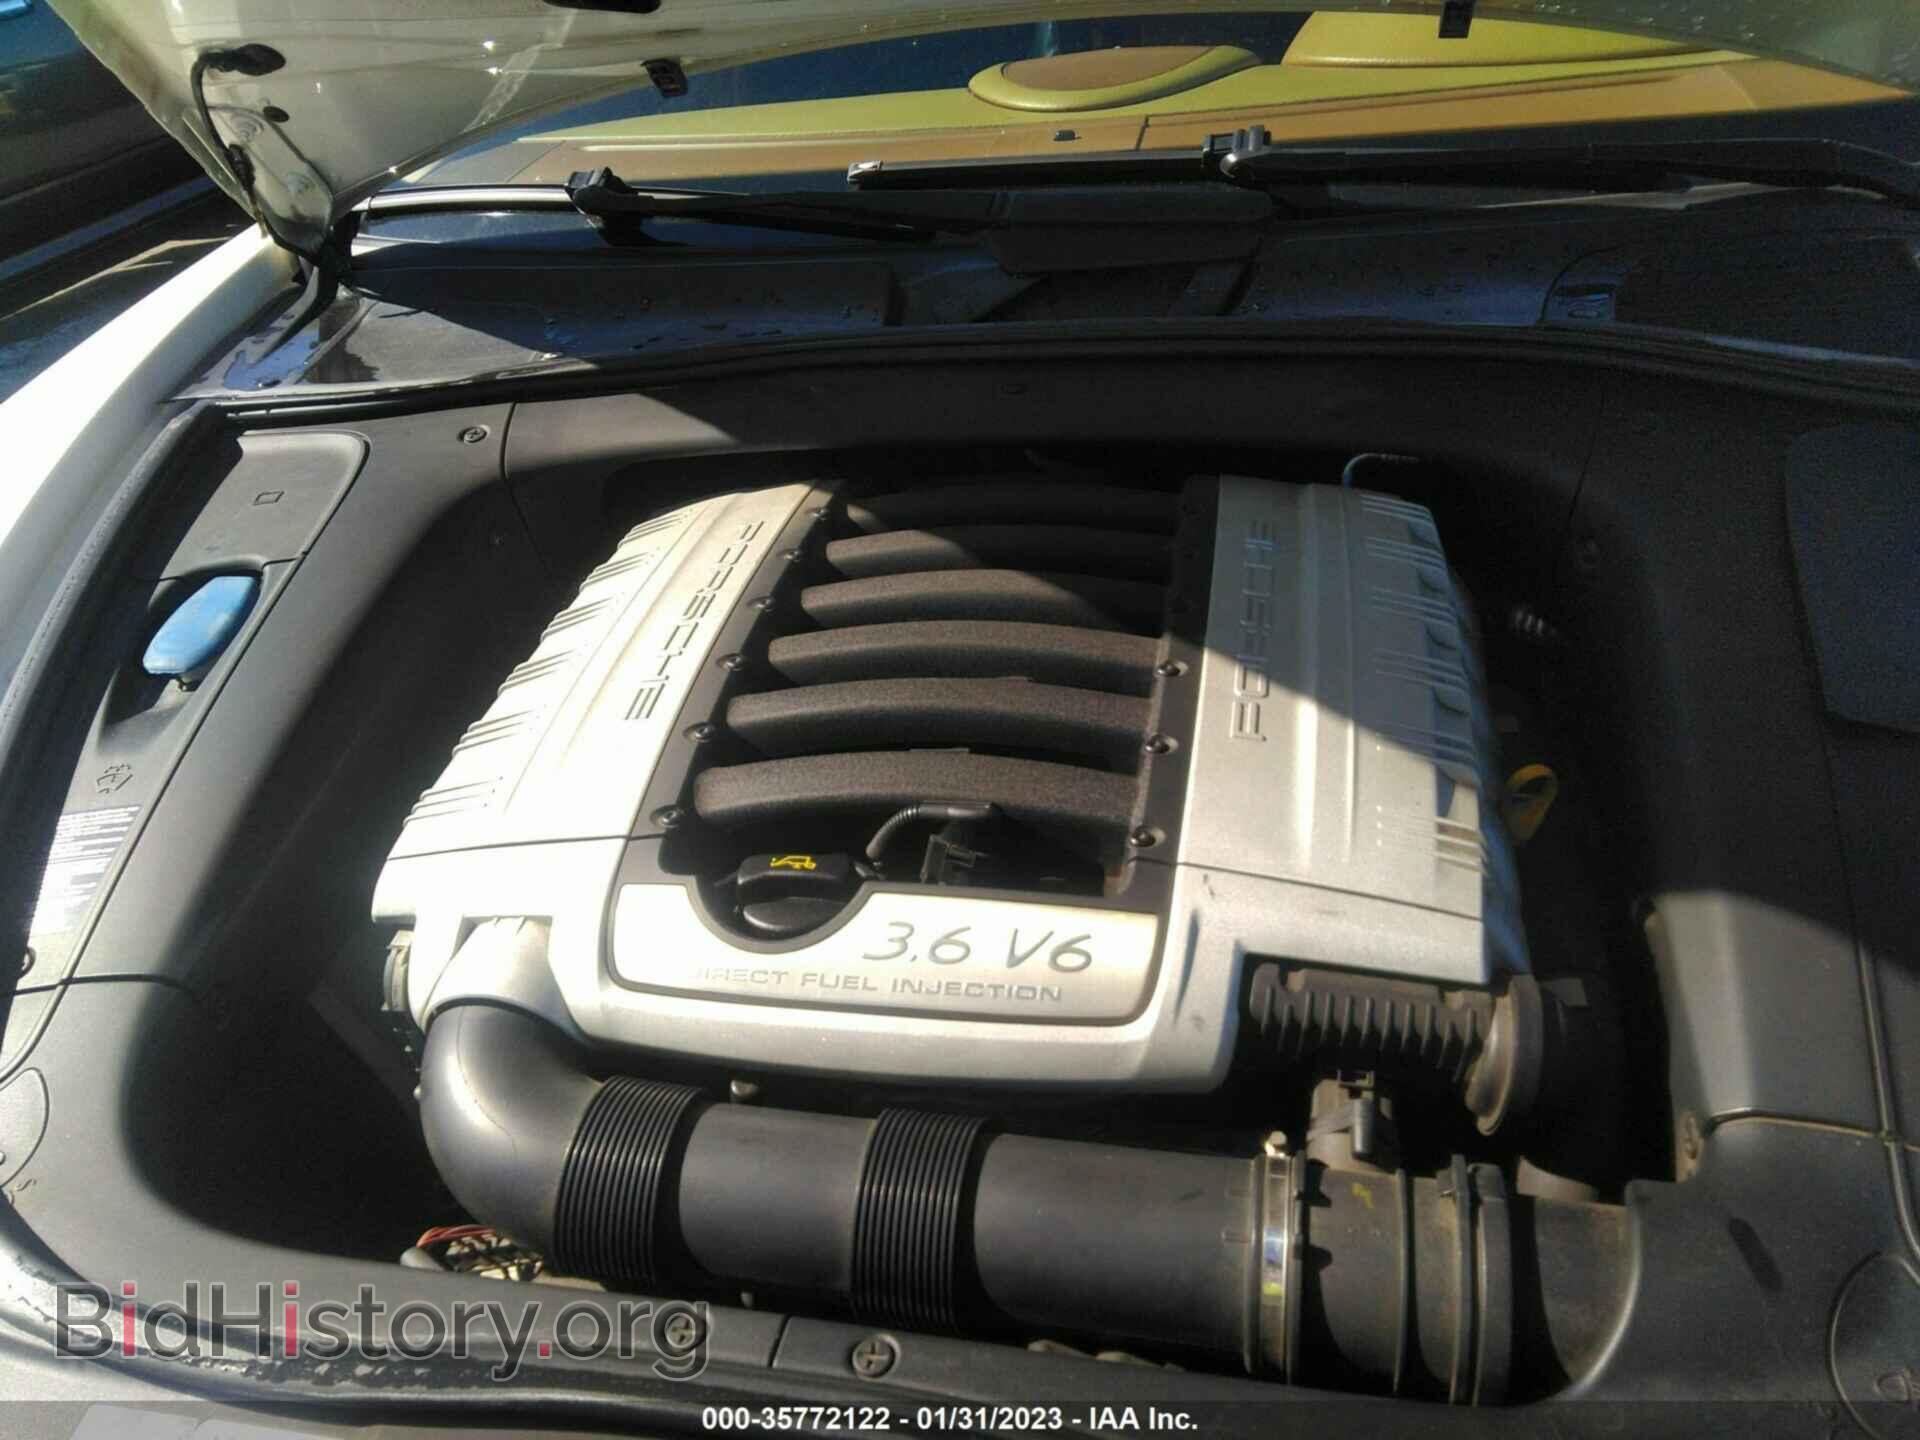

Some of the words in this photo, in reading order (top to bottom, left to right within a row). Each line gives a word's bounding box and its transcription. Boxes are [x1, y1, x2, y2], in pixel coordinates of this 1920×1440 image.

[624, 520, 766, 722] PORSCHE
[1230, 519, 1277, 743] PORSCHE
[801, 972, 878, 993] FUEL
[891, 978, 1064, 1004] INJECTION
[862, 920, 973, 965] 3.6
[1006, 929, 1094, 974] V6
